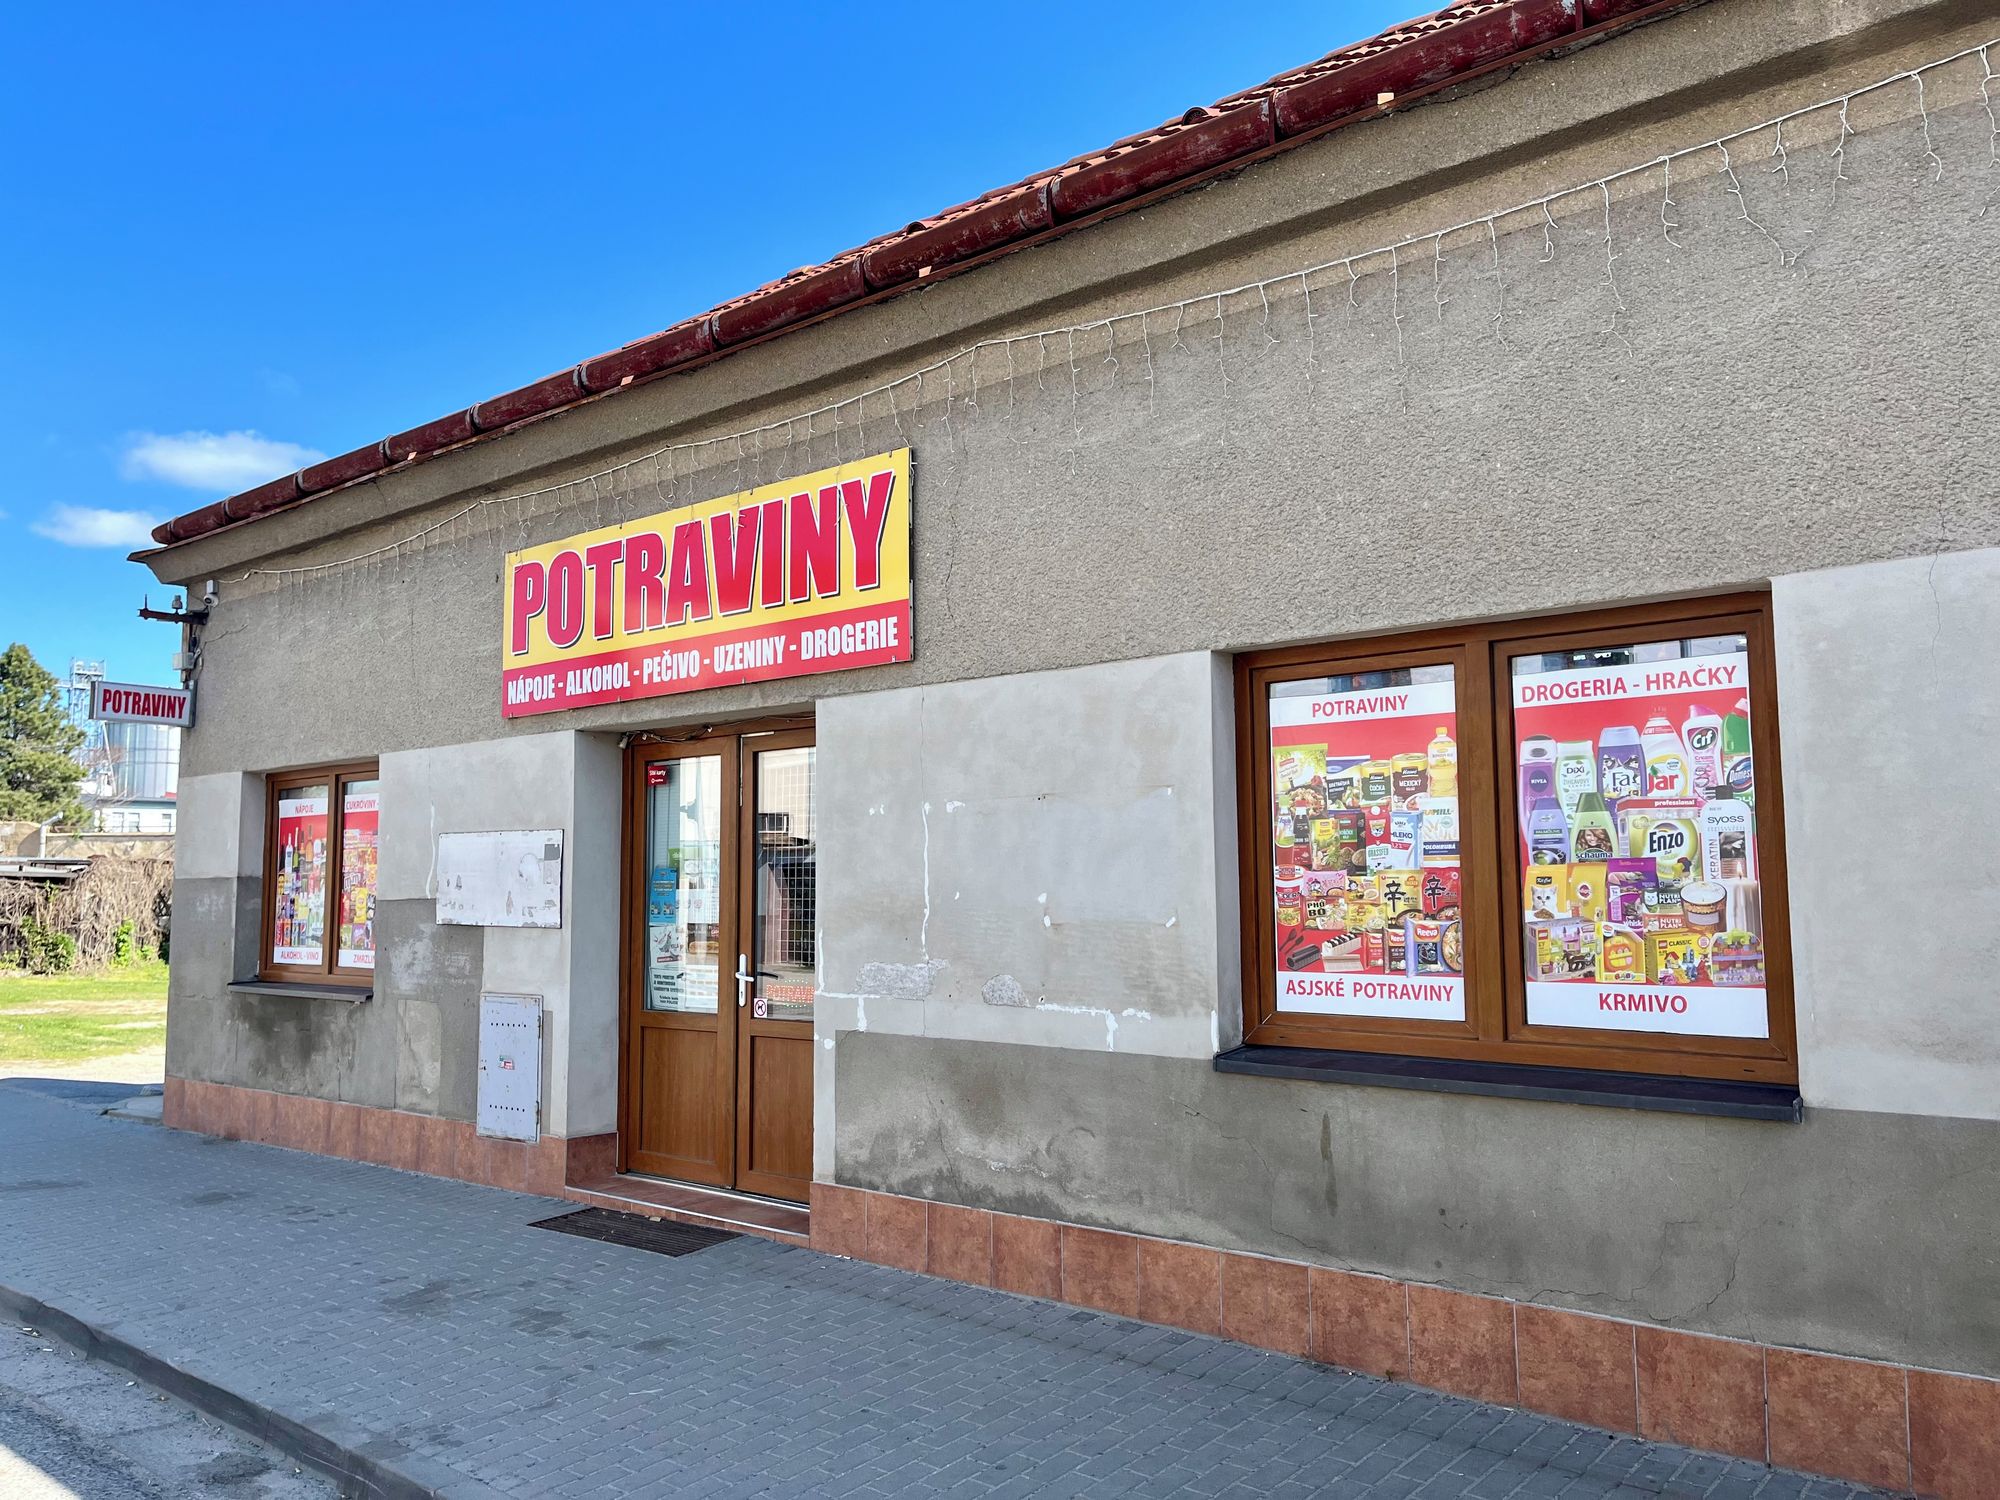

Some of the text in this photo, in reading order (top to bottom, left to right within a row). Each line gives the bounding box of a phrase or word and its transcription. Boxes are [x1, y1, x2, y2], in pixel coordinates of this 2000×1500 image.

[511, 470, 895, 655] POTRAVINY
[507, 674, 556, 705] NÁPOJE
[566, 662, 631, 696] ALKOHOL
[643, 650, 700, 684] PEČIVO
[713, 635, 786, 673] UZENINY
[801, 616, 899, 660] DROGERIE
[1521, 677, 1627, 703] DROGERIA
[1645, 664, 1737, 691] HRAČKY
[101, 688, 187, 719] POTRAVINY
[1311, 694, 1409, 718] POTRAVINY
[1693, 730, 1713, 748] Cif
[1612, 772, 1630, 787] Fa
[1648, 774, 1679, 794] Jar
[295, 804, 314, 814] NÁPOJE
[346, 800, 376, 810] CUKROVINY
[1655, 799, 1695, 808] professional
[1649, 832, 1684, 853] Enzo
[1576, 852, 1613, 860] schauma
[1708, 838, 1719, 880] KERATIN
[1417, 928, 1438, 937] Reeva
[281, 951, 303, 960] ALKOHOL
[1286, 978, 1454, 1002] ASJSKÉ POTRAVINY
[1599, 993, 1688, 1014] KRMIVO
